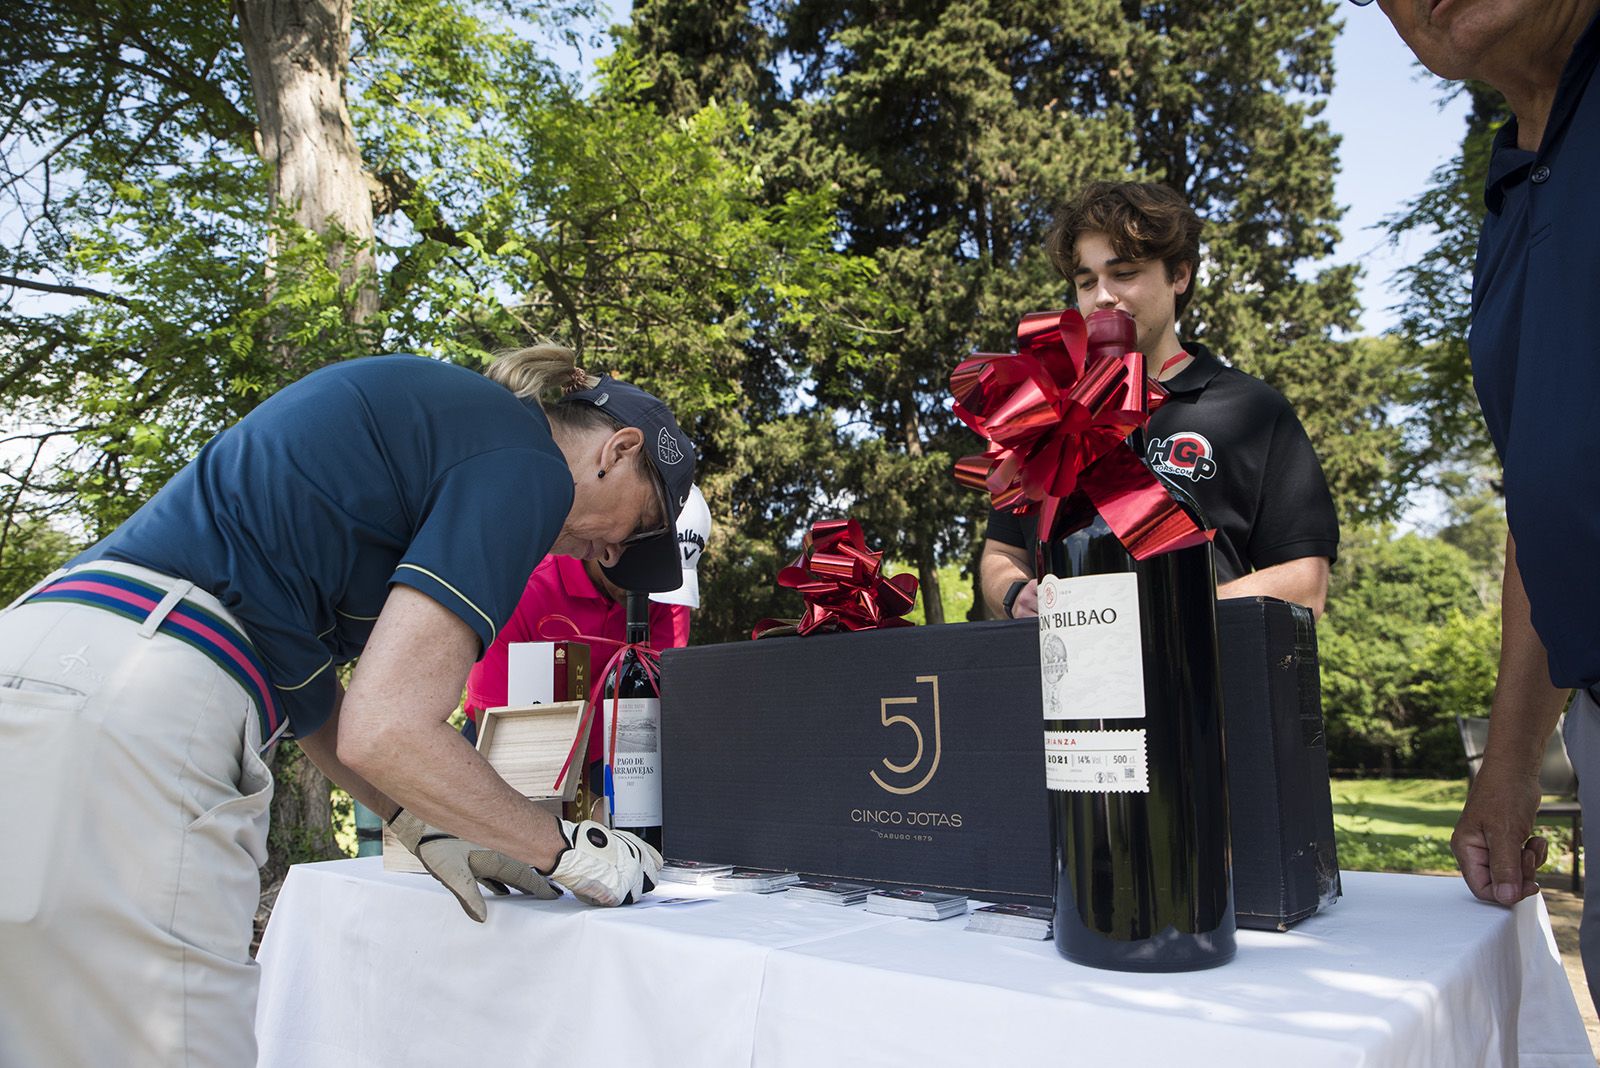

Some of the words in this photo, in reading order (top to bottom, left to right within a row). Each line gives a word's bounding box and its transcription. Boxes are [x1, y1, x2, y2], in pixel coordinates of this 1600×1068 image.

[1148, 437, 1216, 481] HGP
[1055, 607, 1117, 629] BILBAO
[617, 757, 634, 766] PAGO
[635, 757, 645, 765] DE
[1113, 754, 1127, 764] 500
[850, 809, 902, 824] CINCO
[906, 812, 963, 827] JOTAS
